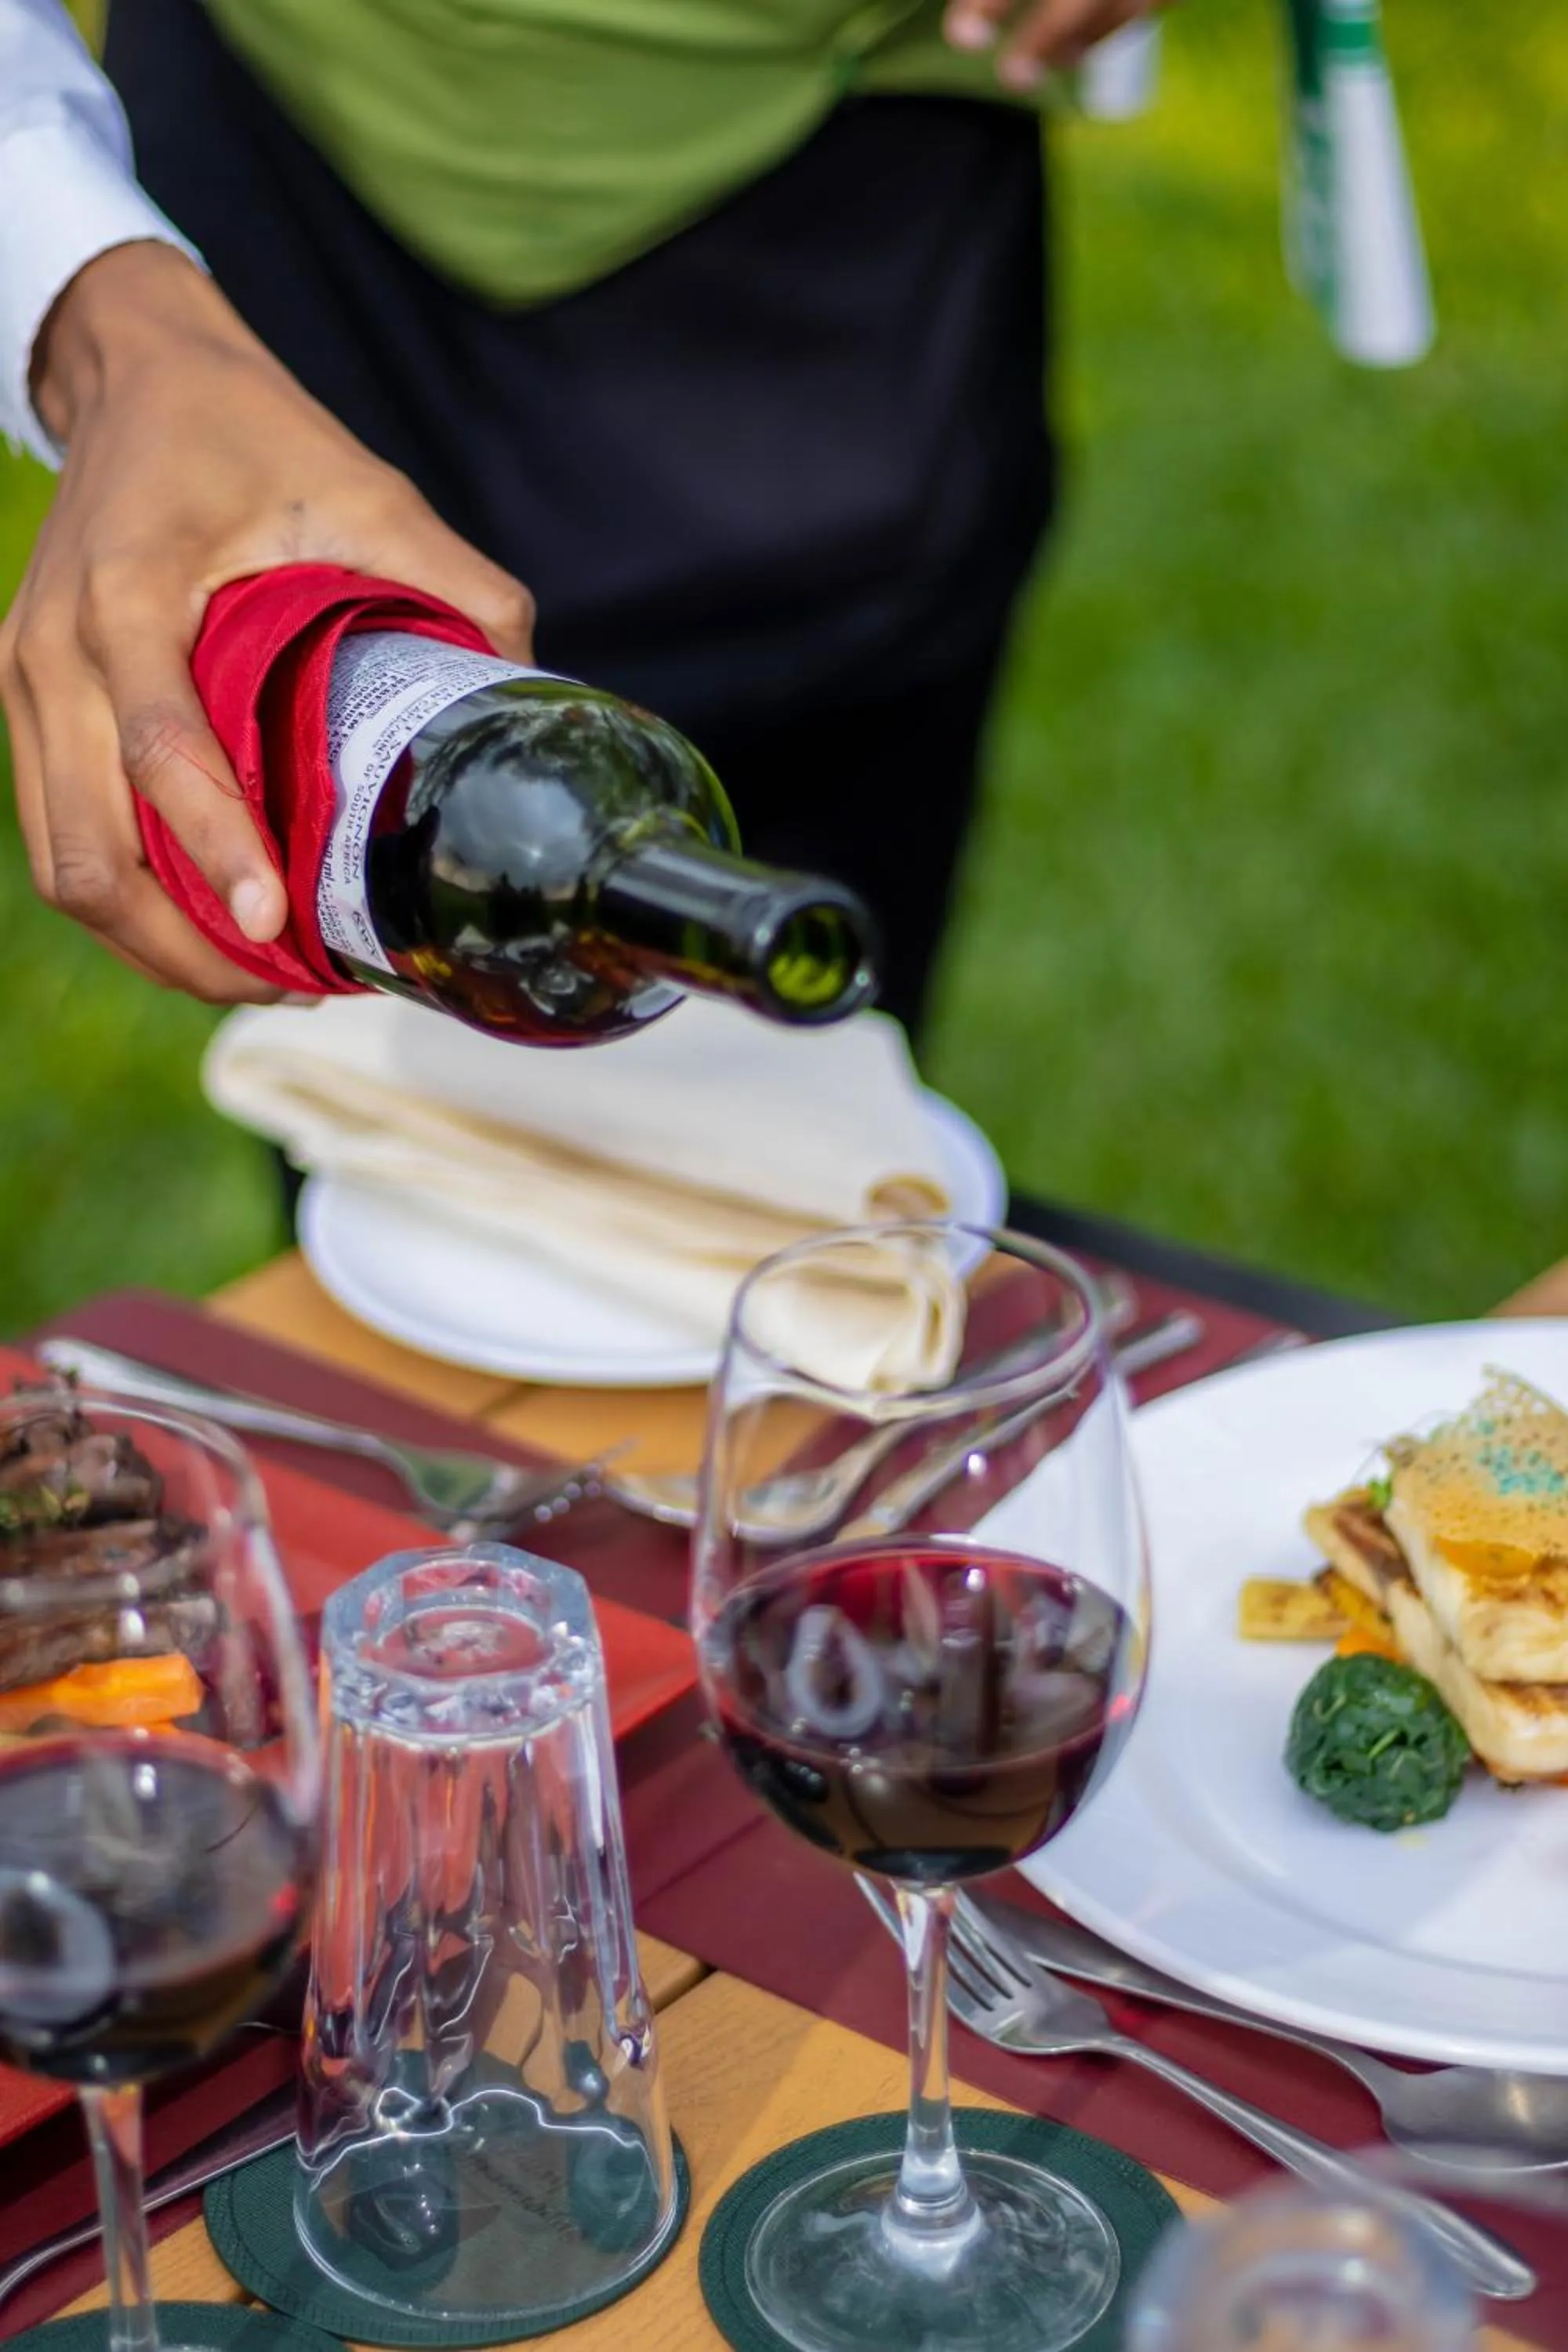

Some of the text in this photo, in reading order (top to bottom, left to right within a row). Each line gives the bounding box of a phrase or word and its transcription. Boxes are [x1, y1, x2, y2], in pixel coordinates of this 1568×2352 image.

[346, 784, 365, 828] SOUTH
[351, 739, 402, 879] SAUVIGNON
[343, 835, 353, 884] AFRICA
